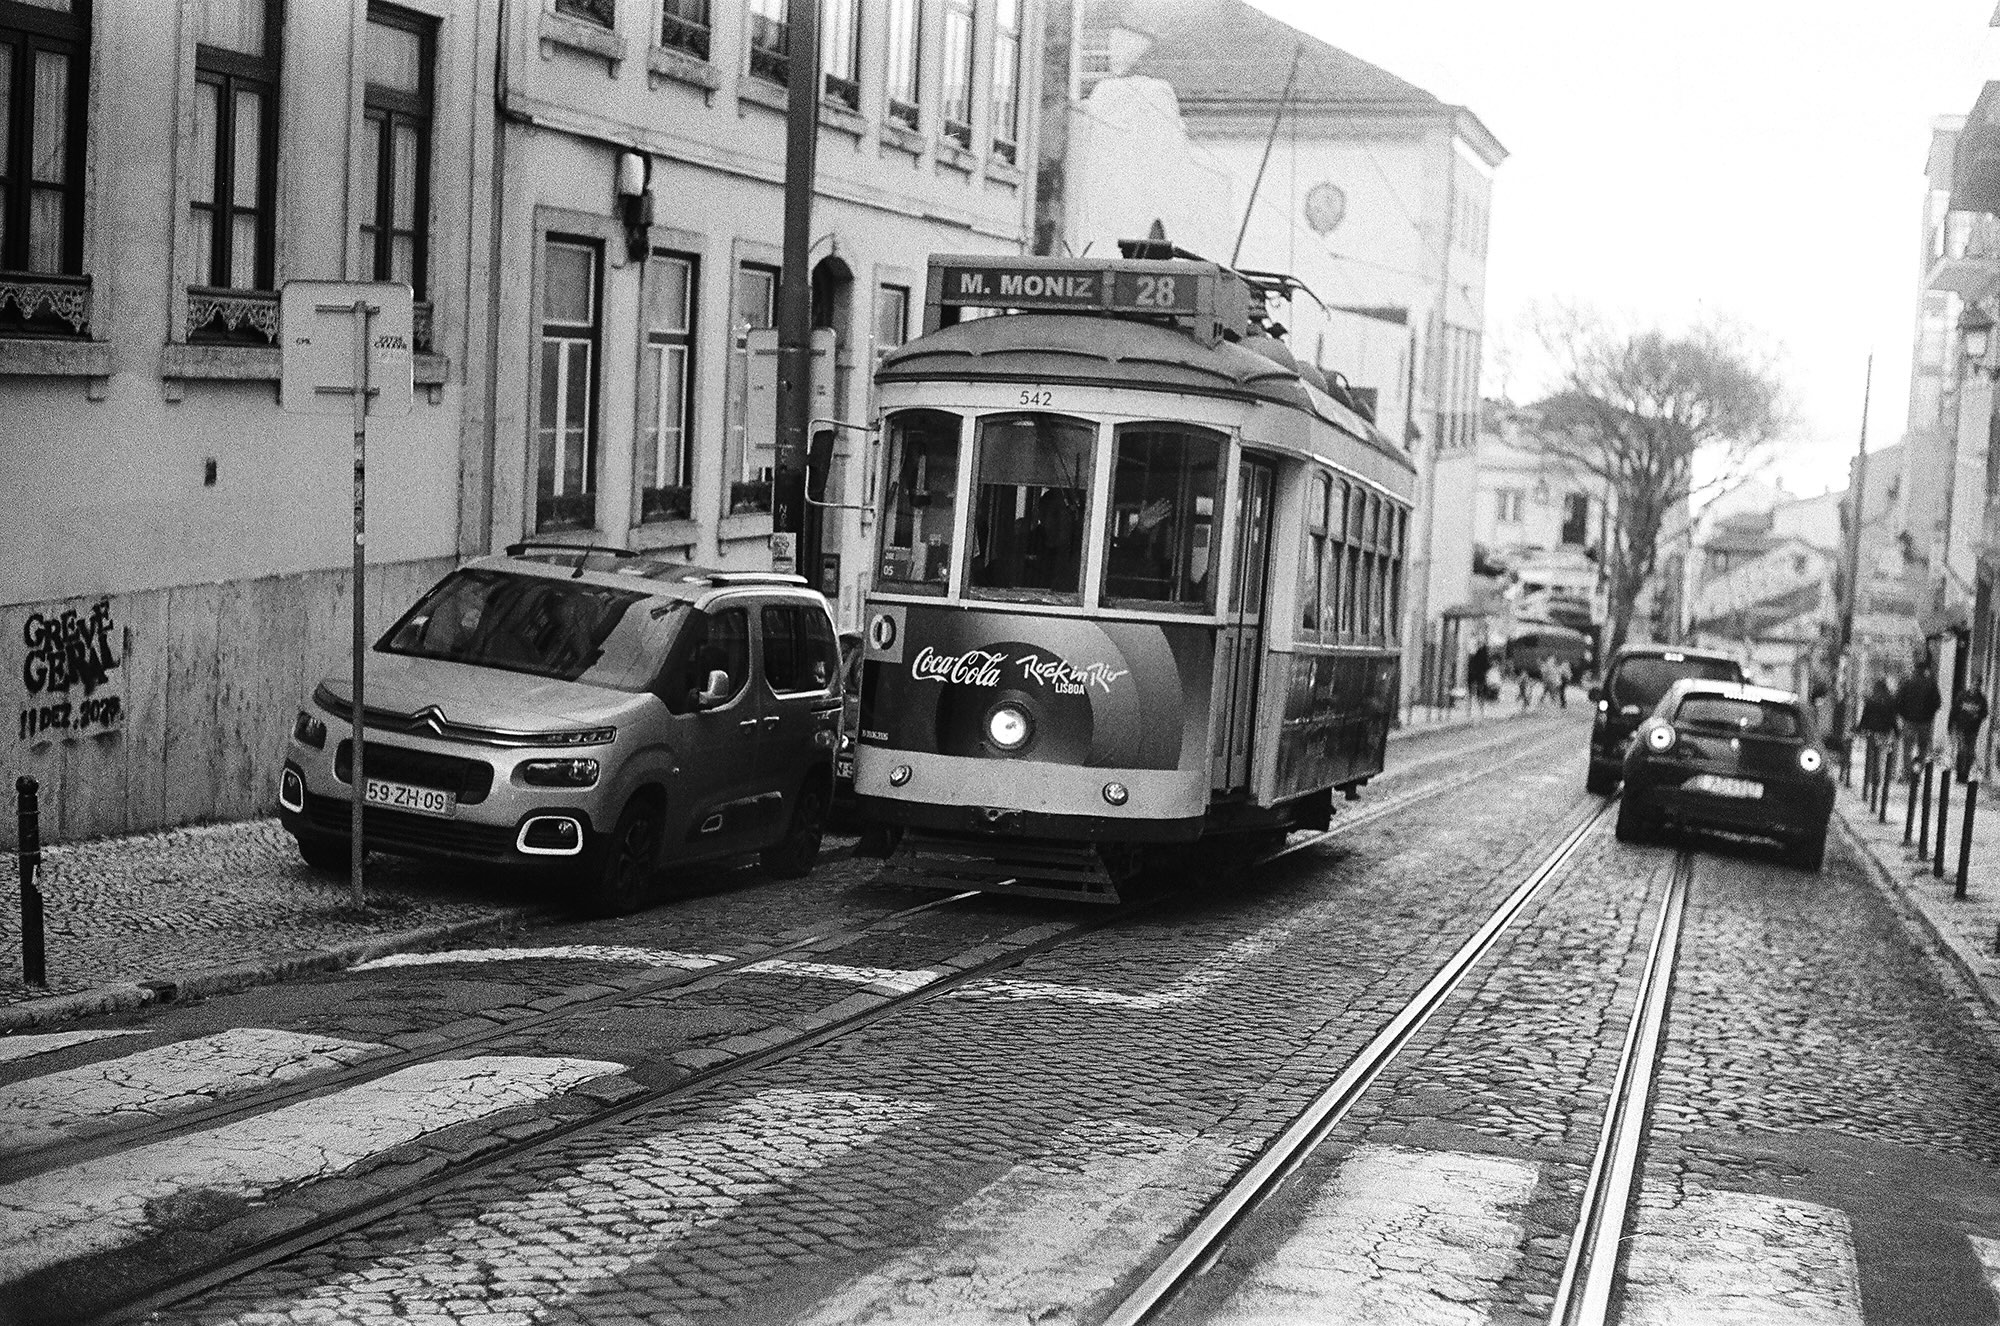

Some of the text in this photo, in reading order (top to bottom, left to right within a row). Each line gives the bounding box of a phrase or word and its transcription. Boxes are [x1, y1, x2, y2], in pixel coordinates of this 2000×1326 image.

[960, 273, 1093, 298] M. MONIZ
[1136, 275, 1176, 307] 28
[1020, 390, 1052, 406] 542
[23, 600, 114, 654] GREVE
[911, 646, 1009, 688] Coca-Cola
[1015, 654, 1129, 693] Rock in Rio
[1055, 683, 1085, 695] LISBOA
